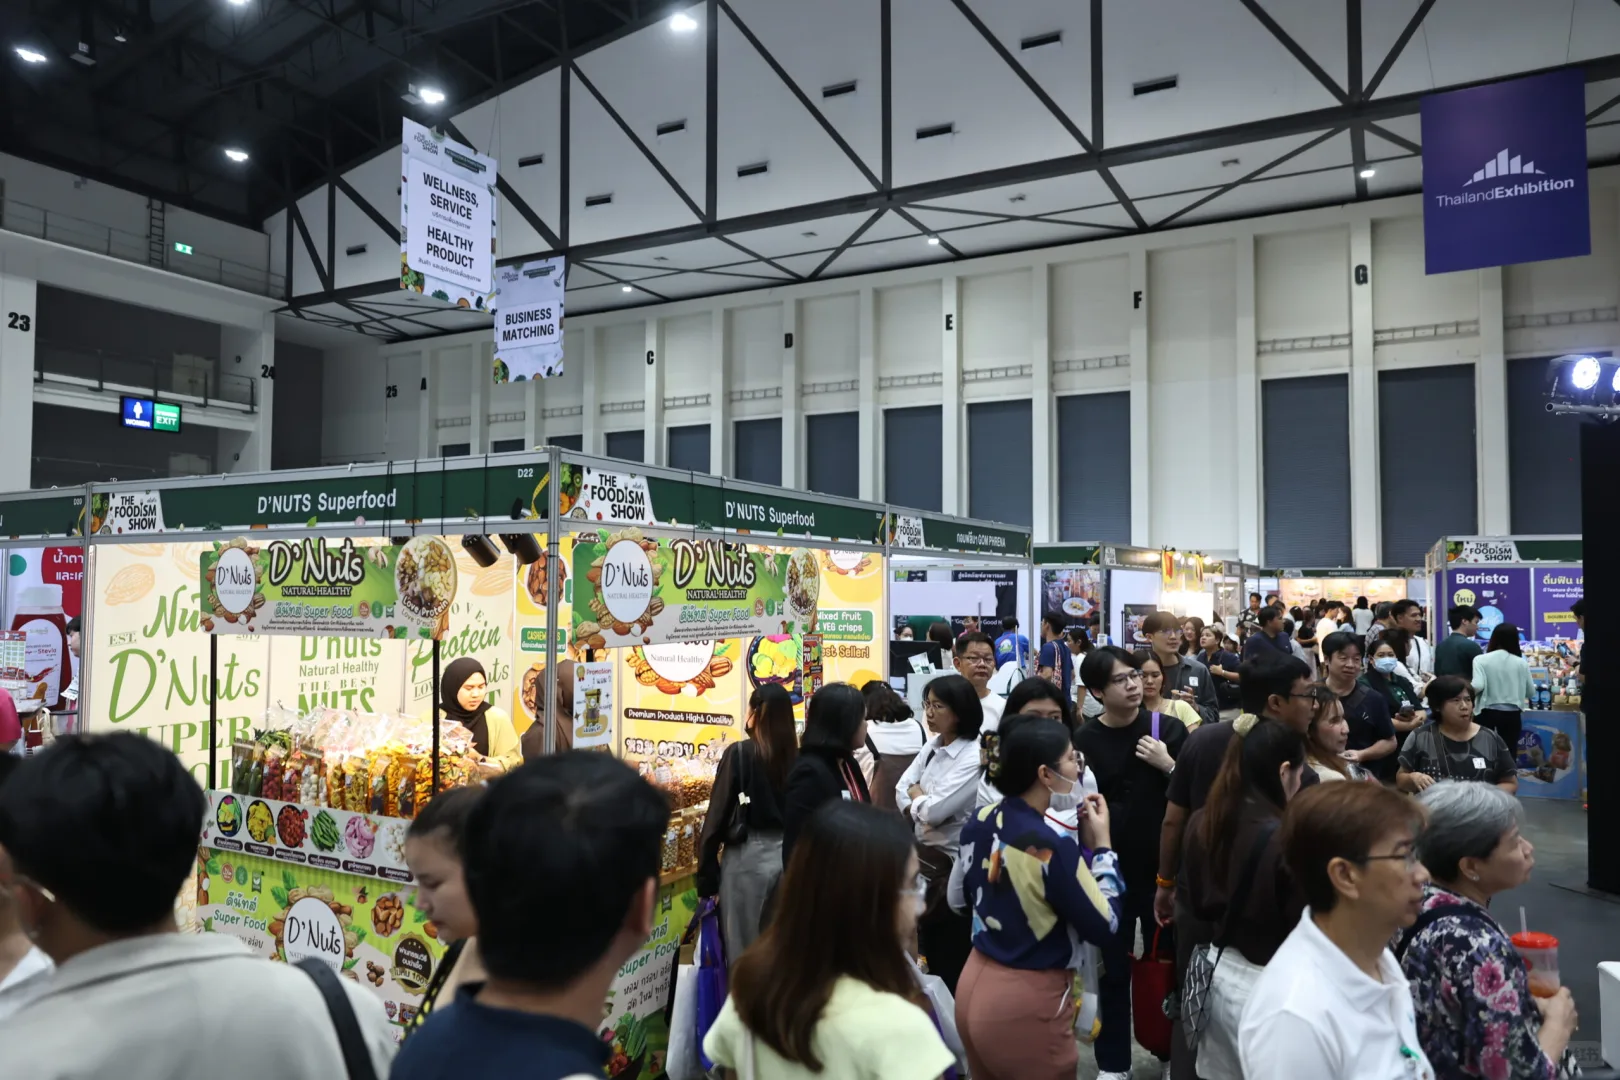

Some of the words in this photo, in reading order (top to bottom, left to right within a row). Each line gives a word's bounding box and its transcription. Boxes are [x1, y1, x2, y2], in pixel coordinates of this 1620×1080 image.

[423, 172, 479, 208] WELLNESS,
[1436, 178, 1574, 207] ThailandExhibition
[430, 193, 472, 220] SERVICE
[427, 225, 473, 252] HEALTHY
[426, 242, 474, 269] PRODUCT
[1355, 265, 1368, 285] G
[1134, 291, 1142, 309] F
[8, 312, 31, 332] 23
[505, 307, 552, 325] BUSINESS
[945, 315, 954, 331] E
[502, 323, 554, 342] MATCHING
[785, 333, 793, 349] D
[647, 350, 654, 365] C
[386, 385, 398, 398] 25
[420, 378, 427, 391] A
[156, 416, 177, 426] EXIT
[518, 468, 533, 478] D22
[599, 474, 617, 487] THE
[121, 495, 135, 506] THE
[257, 493, 311, 514] D'NUTS
[317, 488, 397, 514] Superfood
[591, 482, 645, 506] FOODISM
[115, 503, 157, 518] FOODISM
[611, 504, 645, 520] SHOW
[725, 501, 766, 521] D'NUTS
[769, 507, 815, 527] Superfood
[129, 518, 157, 530] SHOW
[903, 518, 911, 527] THE
[907, 535, 921, 545] SHOW
[978, 533, 989, 546] GOM
[989, 535, 1007, 548] PHRENA
[1469, 546, 1512, 555] FOODISM
[268, 536, 366, 587] D'Nuts
[672, 539, 756, 588] D'Nuts
[217, 565, 252, 586] D'Nuts
[604, 562, 649, 588] D'Nuts
[1456, 572, 1509, 584] Barista
[282, 586, 315, 596] NATURAL
[316, 586, 351, 596] HEALTHY
[687, 590, 718, 600] NATURAL
[719, 590, 747, 599] HEALTHY
[304, 605, 331, 619] Super
[331, 605, 353, 618] Food
[402, 597, 420, 614] Love
[420, 598, 449, 618] Protein
[708, 608, 732, 624] Super
[732, 608, 750, 621] Food
[841, 611, 862, 621] fruit
[823, 622, 836, 631] VEG
[838, 622, 863, 634] crisps
[651, 653, 675, 662] Natural
[677, 653, 704, 664] Healthy
[838, 645, 870, 658] Seller!
[299, 664, 339, 677] Natural
[342, 660, 380, 676] Healthy
[108, 648, 262, 725] D'Nuts
[298, 681, 331, 693] THE
[340, 676, 377, 689] BEST
[628, 709, 656, 719] Premium
[657, 711, 684, 721] Product
[706, 715, 733, 725] Quality
[213, 909, 240, 926] Super
[243, 916, 267, 931] Food
[288, 916, 341, 955] D'Nuts
[654, 936, 679, 961] Food
